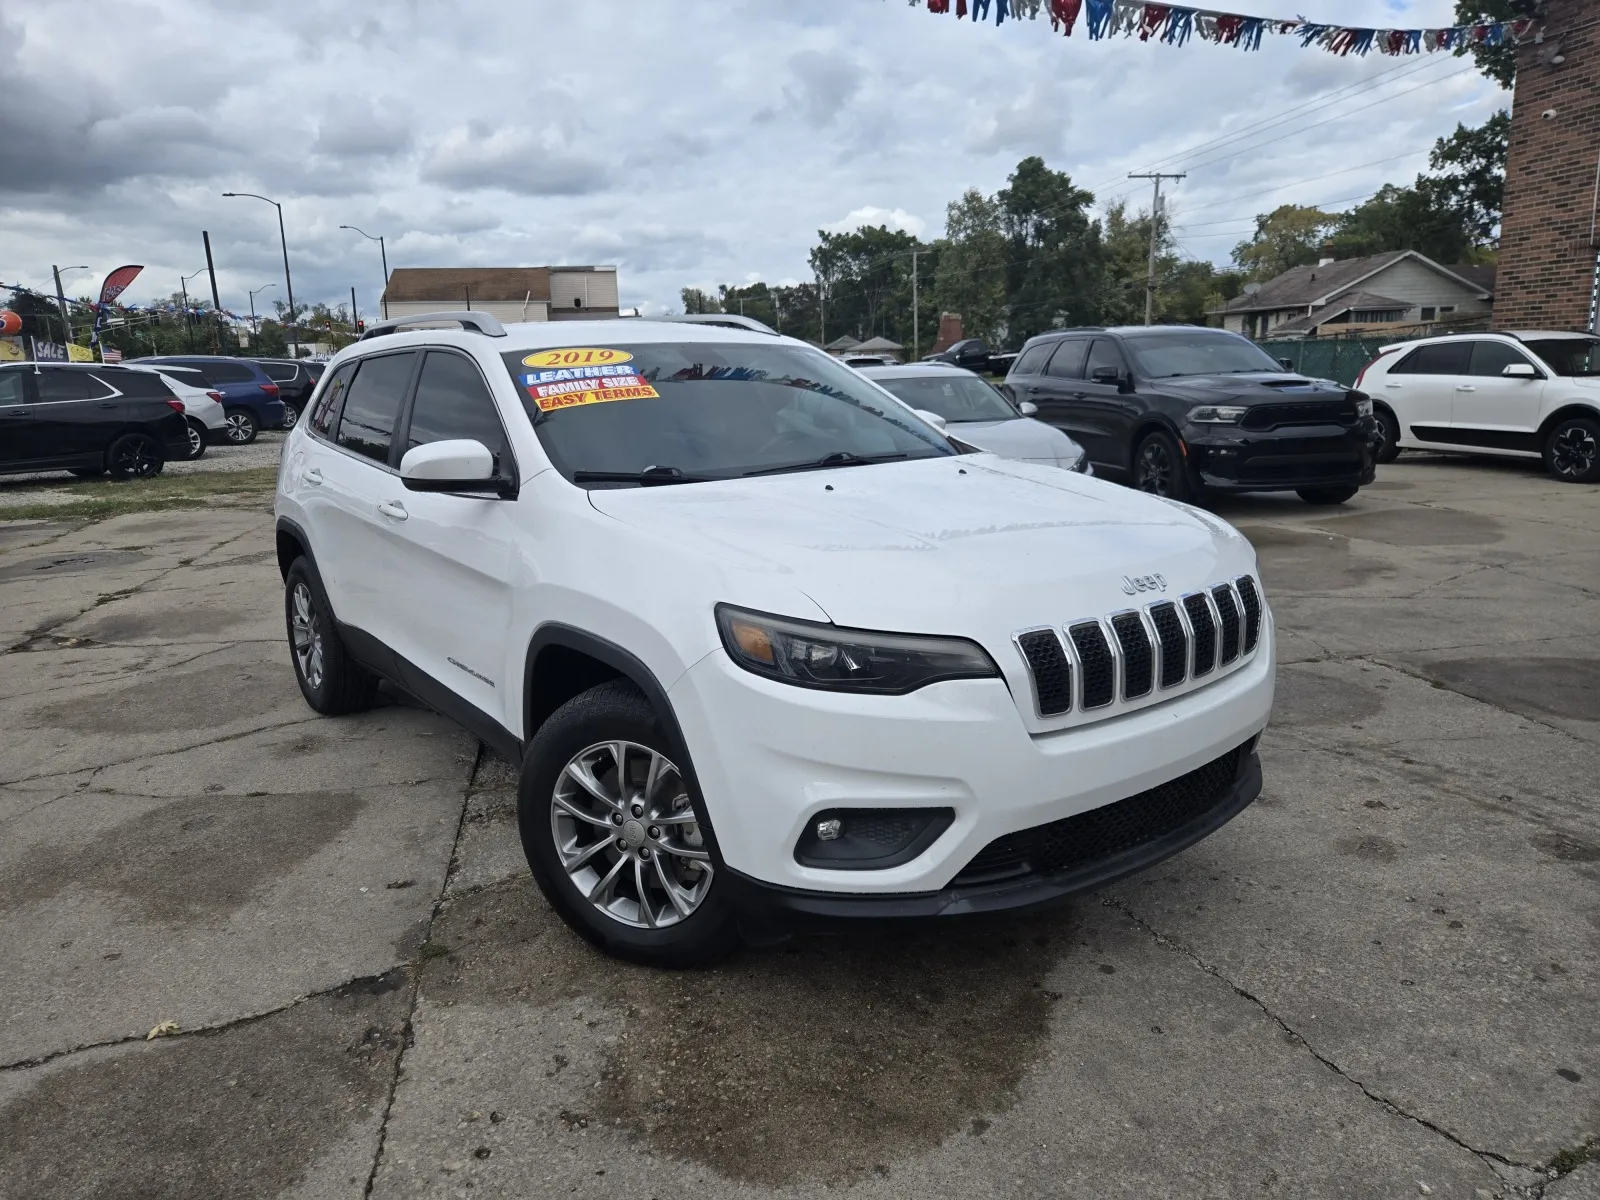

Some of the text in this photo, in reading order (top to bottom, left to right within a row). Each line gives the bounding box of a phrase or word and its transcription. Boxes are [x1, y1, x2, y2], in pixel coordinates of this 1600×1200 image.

[37, 341, 65, 359] SALE
[545, 350, 614, 366] 2019
[526, 365, 635, 386] LEATHER
[536, 376, 641, 398] FAMILY SIZE
[539, 386, 655, 410] EASY TERMS
[1120, 573, 1167, 595] Jeep
